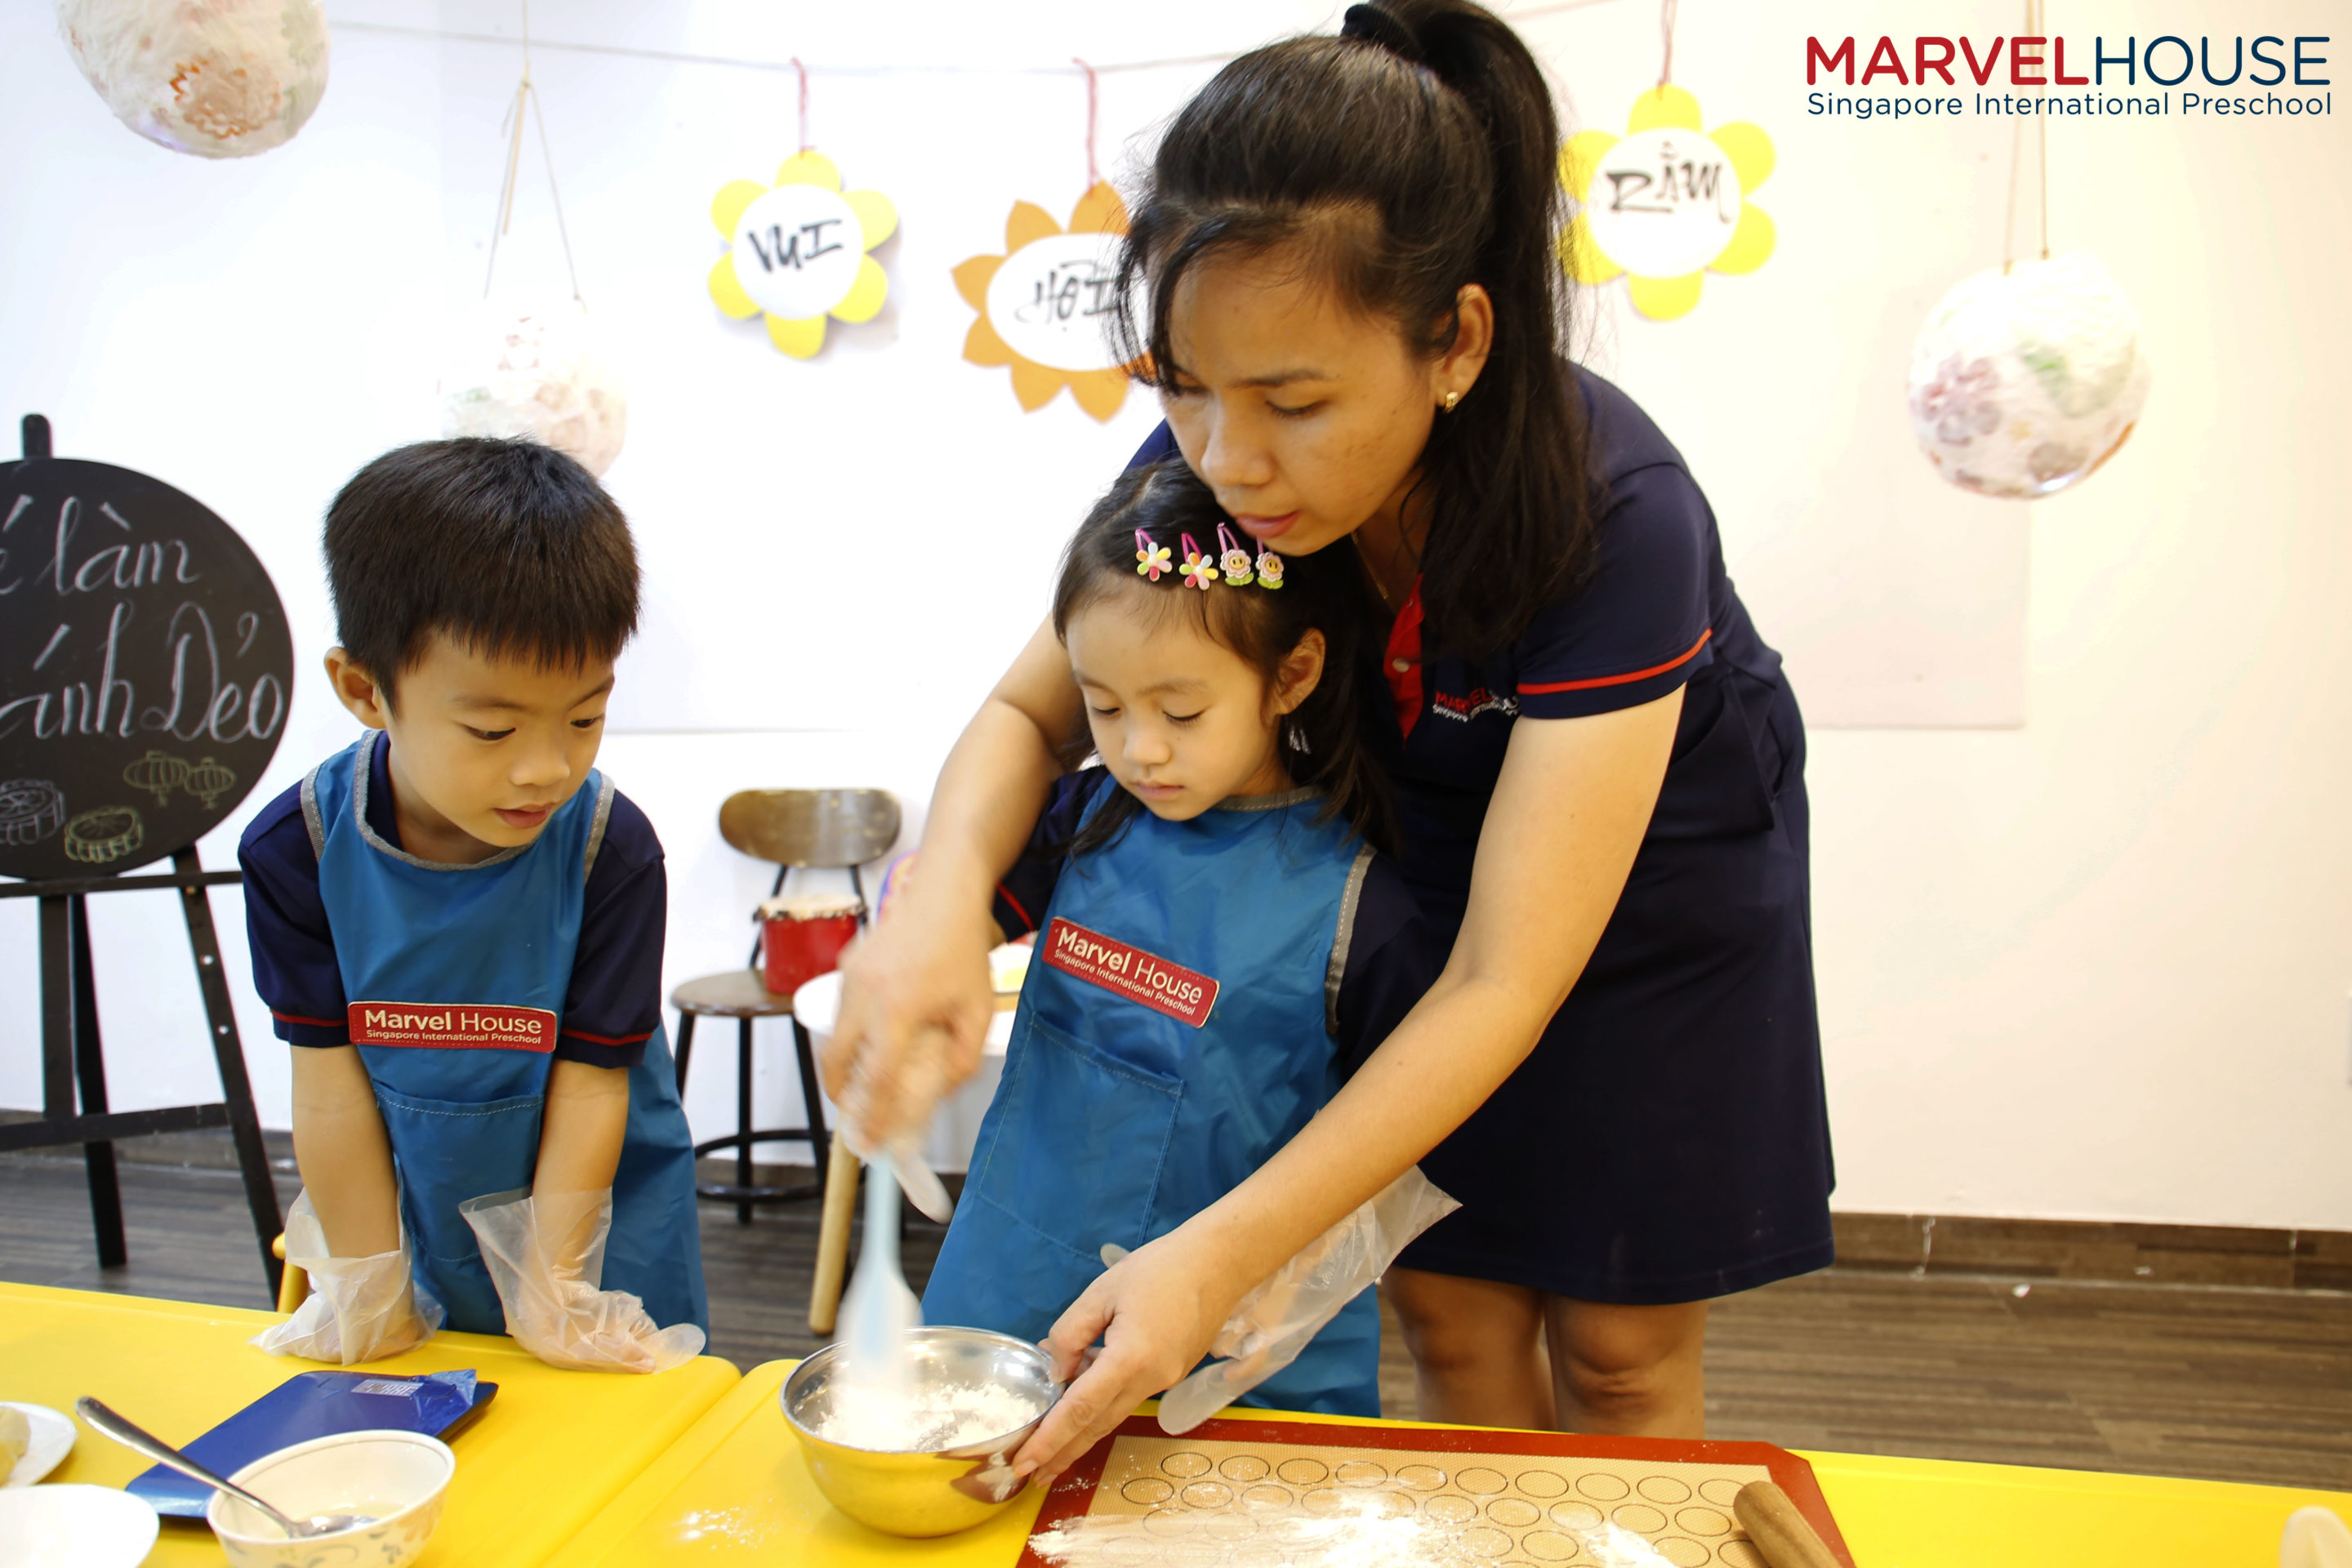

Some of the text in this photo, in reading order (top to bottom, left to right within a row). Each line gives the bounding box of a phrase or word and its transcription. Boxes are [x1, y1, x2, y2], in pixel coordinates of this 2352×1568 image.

[747, 220, 843, 273] VUI
[38, 496, 201, 594] làm
[1054, 948, 1196, 1016] Singapore International Preschool
[1057, 926, 1203, 1004] Marvel House
[364, 1009, 542, 1034] Marvel House
[366, 1029, 541, 1045] Singapore International Preschool
